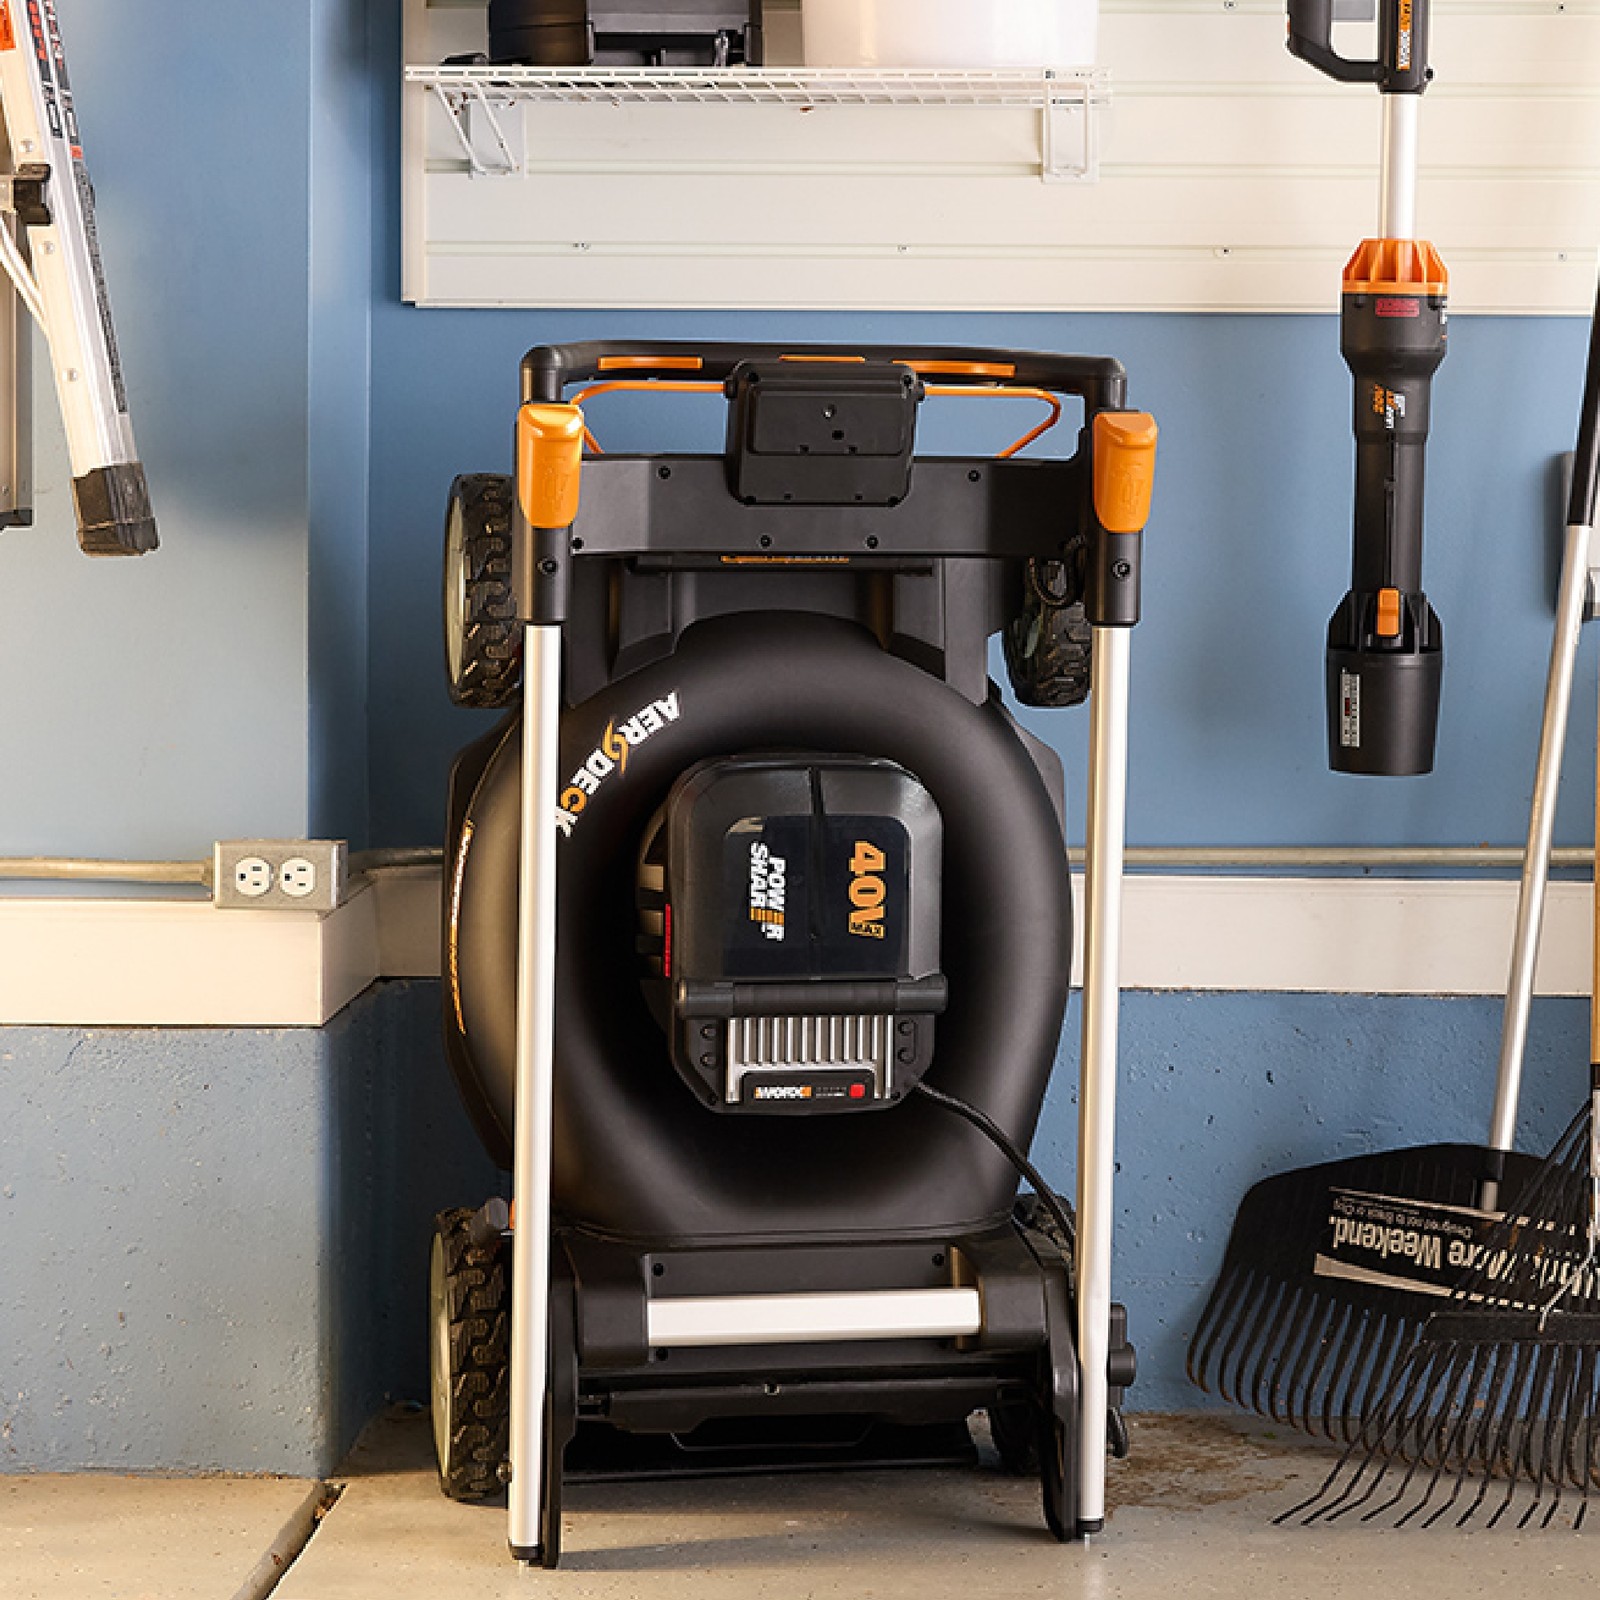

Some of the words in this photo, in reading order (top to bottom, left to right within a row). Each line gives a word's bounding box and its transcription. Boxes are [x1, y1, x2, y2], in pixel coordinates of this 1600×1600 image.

[750, 841, 768, 922] SHARE
[767, 857, 786, 941] POWER
[1328, 1213, 1441, 1271] Weekend.
